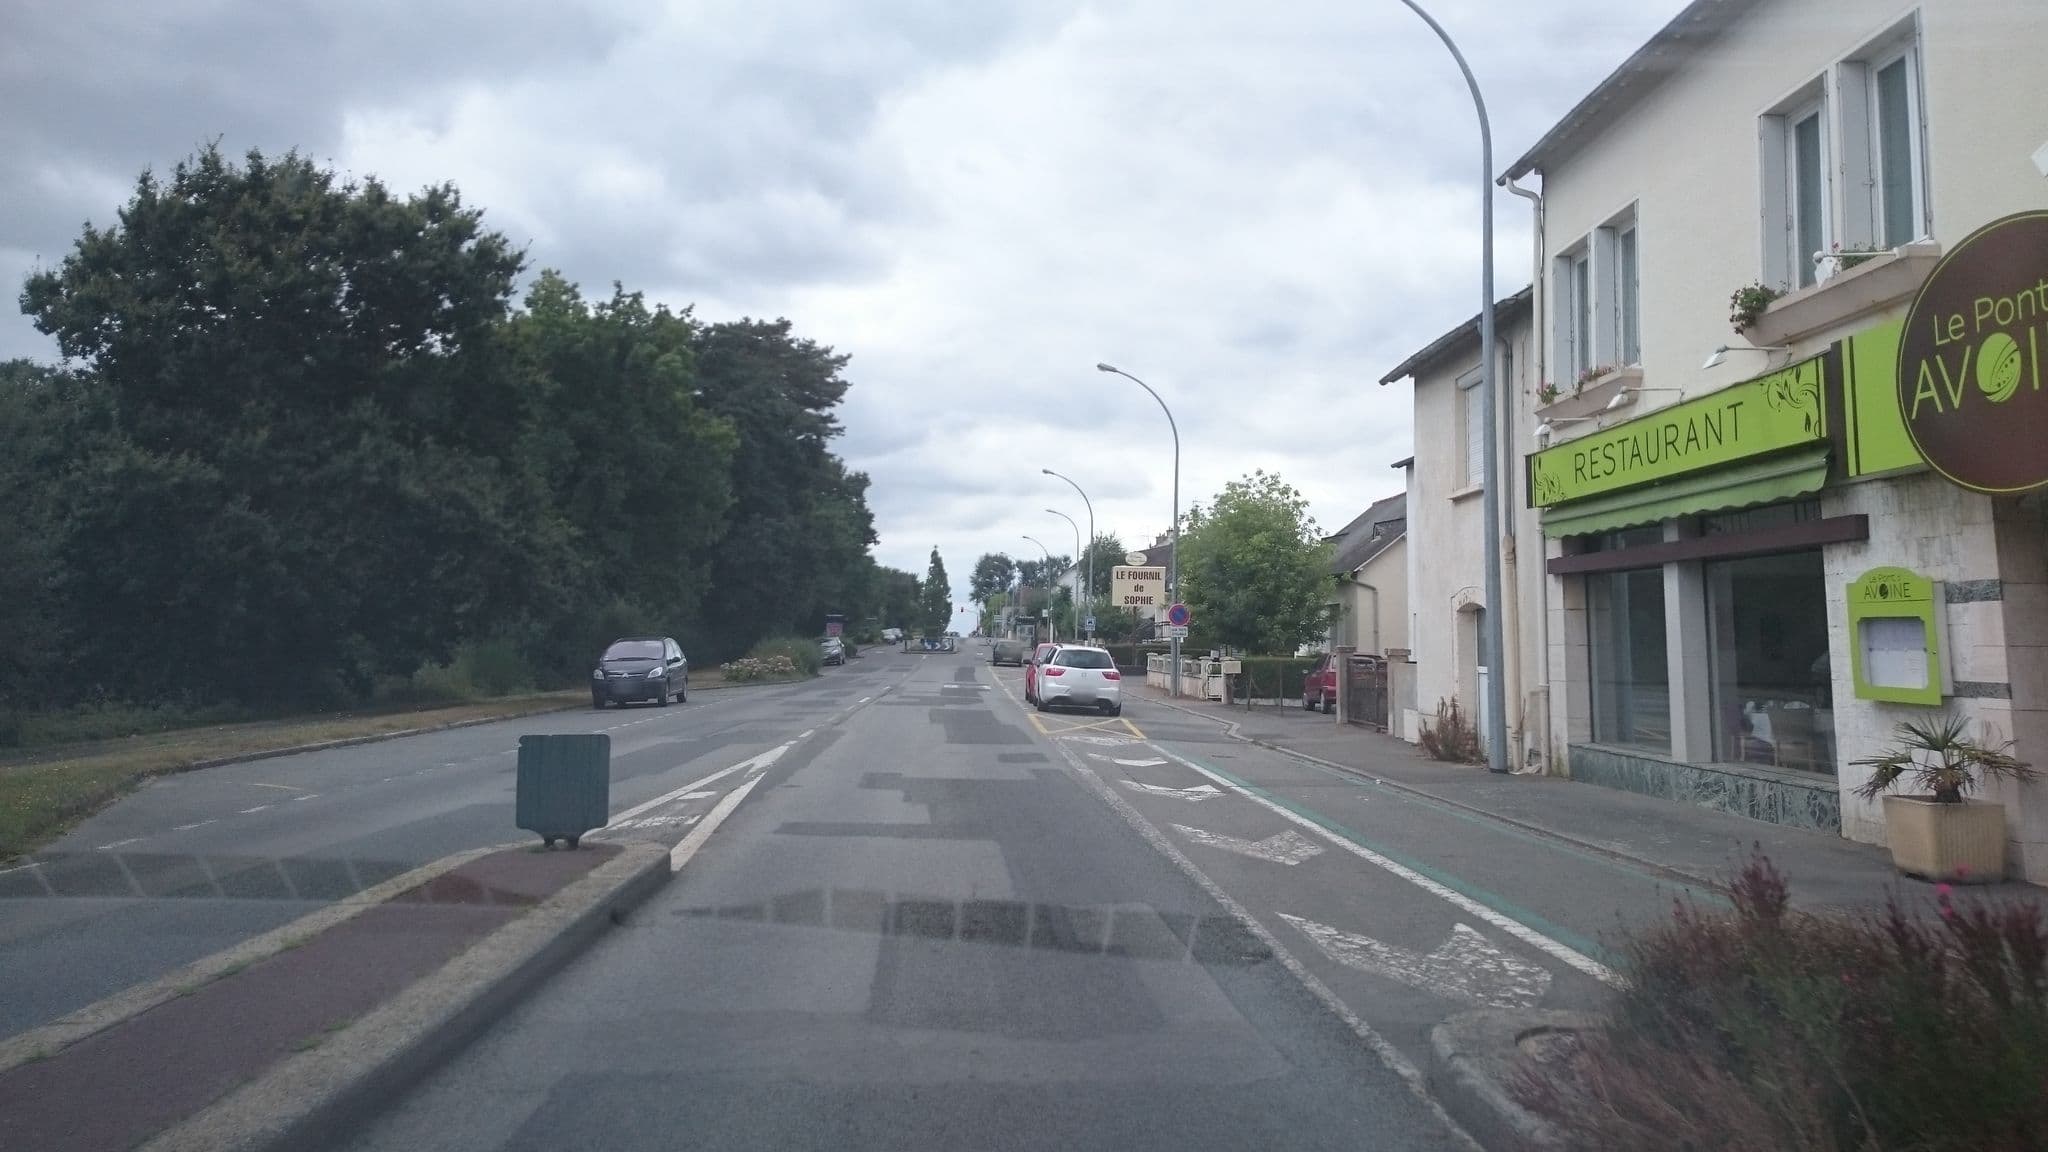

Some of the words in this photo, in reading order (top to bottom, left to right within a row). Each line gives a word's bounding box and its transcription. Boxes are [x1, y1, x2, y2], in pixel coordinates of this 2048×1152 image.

[1934, 313, 1965, 346] Le
[1974, 279, 2048, 333] Pont
[1911, 324, 2048, 420] AVOI
[1574, 401, 1743, 484] RESTAURANT
[1116, 571, 1125, 580] LE
[1128, 571, 1162, 580] FOURNIL
[1134, 583, 1144, 592] de
[1864, 582, 1911, 600] AVOINE
[1124, 596, 1154, 604] SOPHIE
